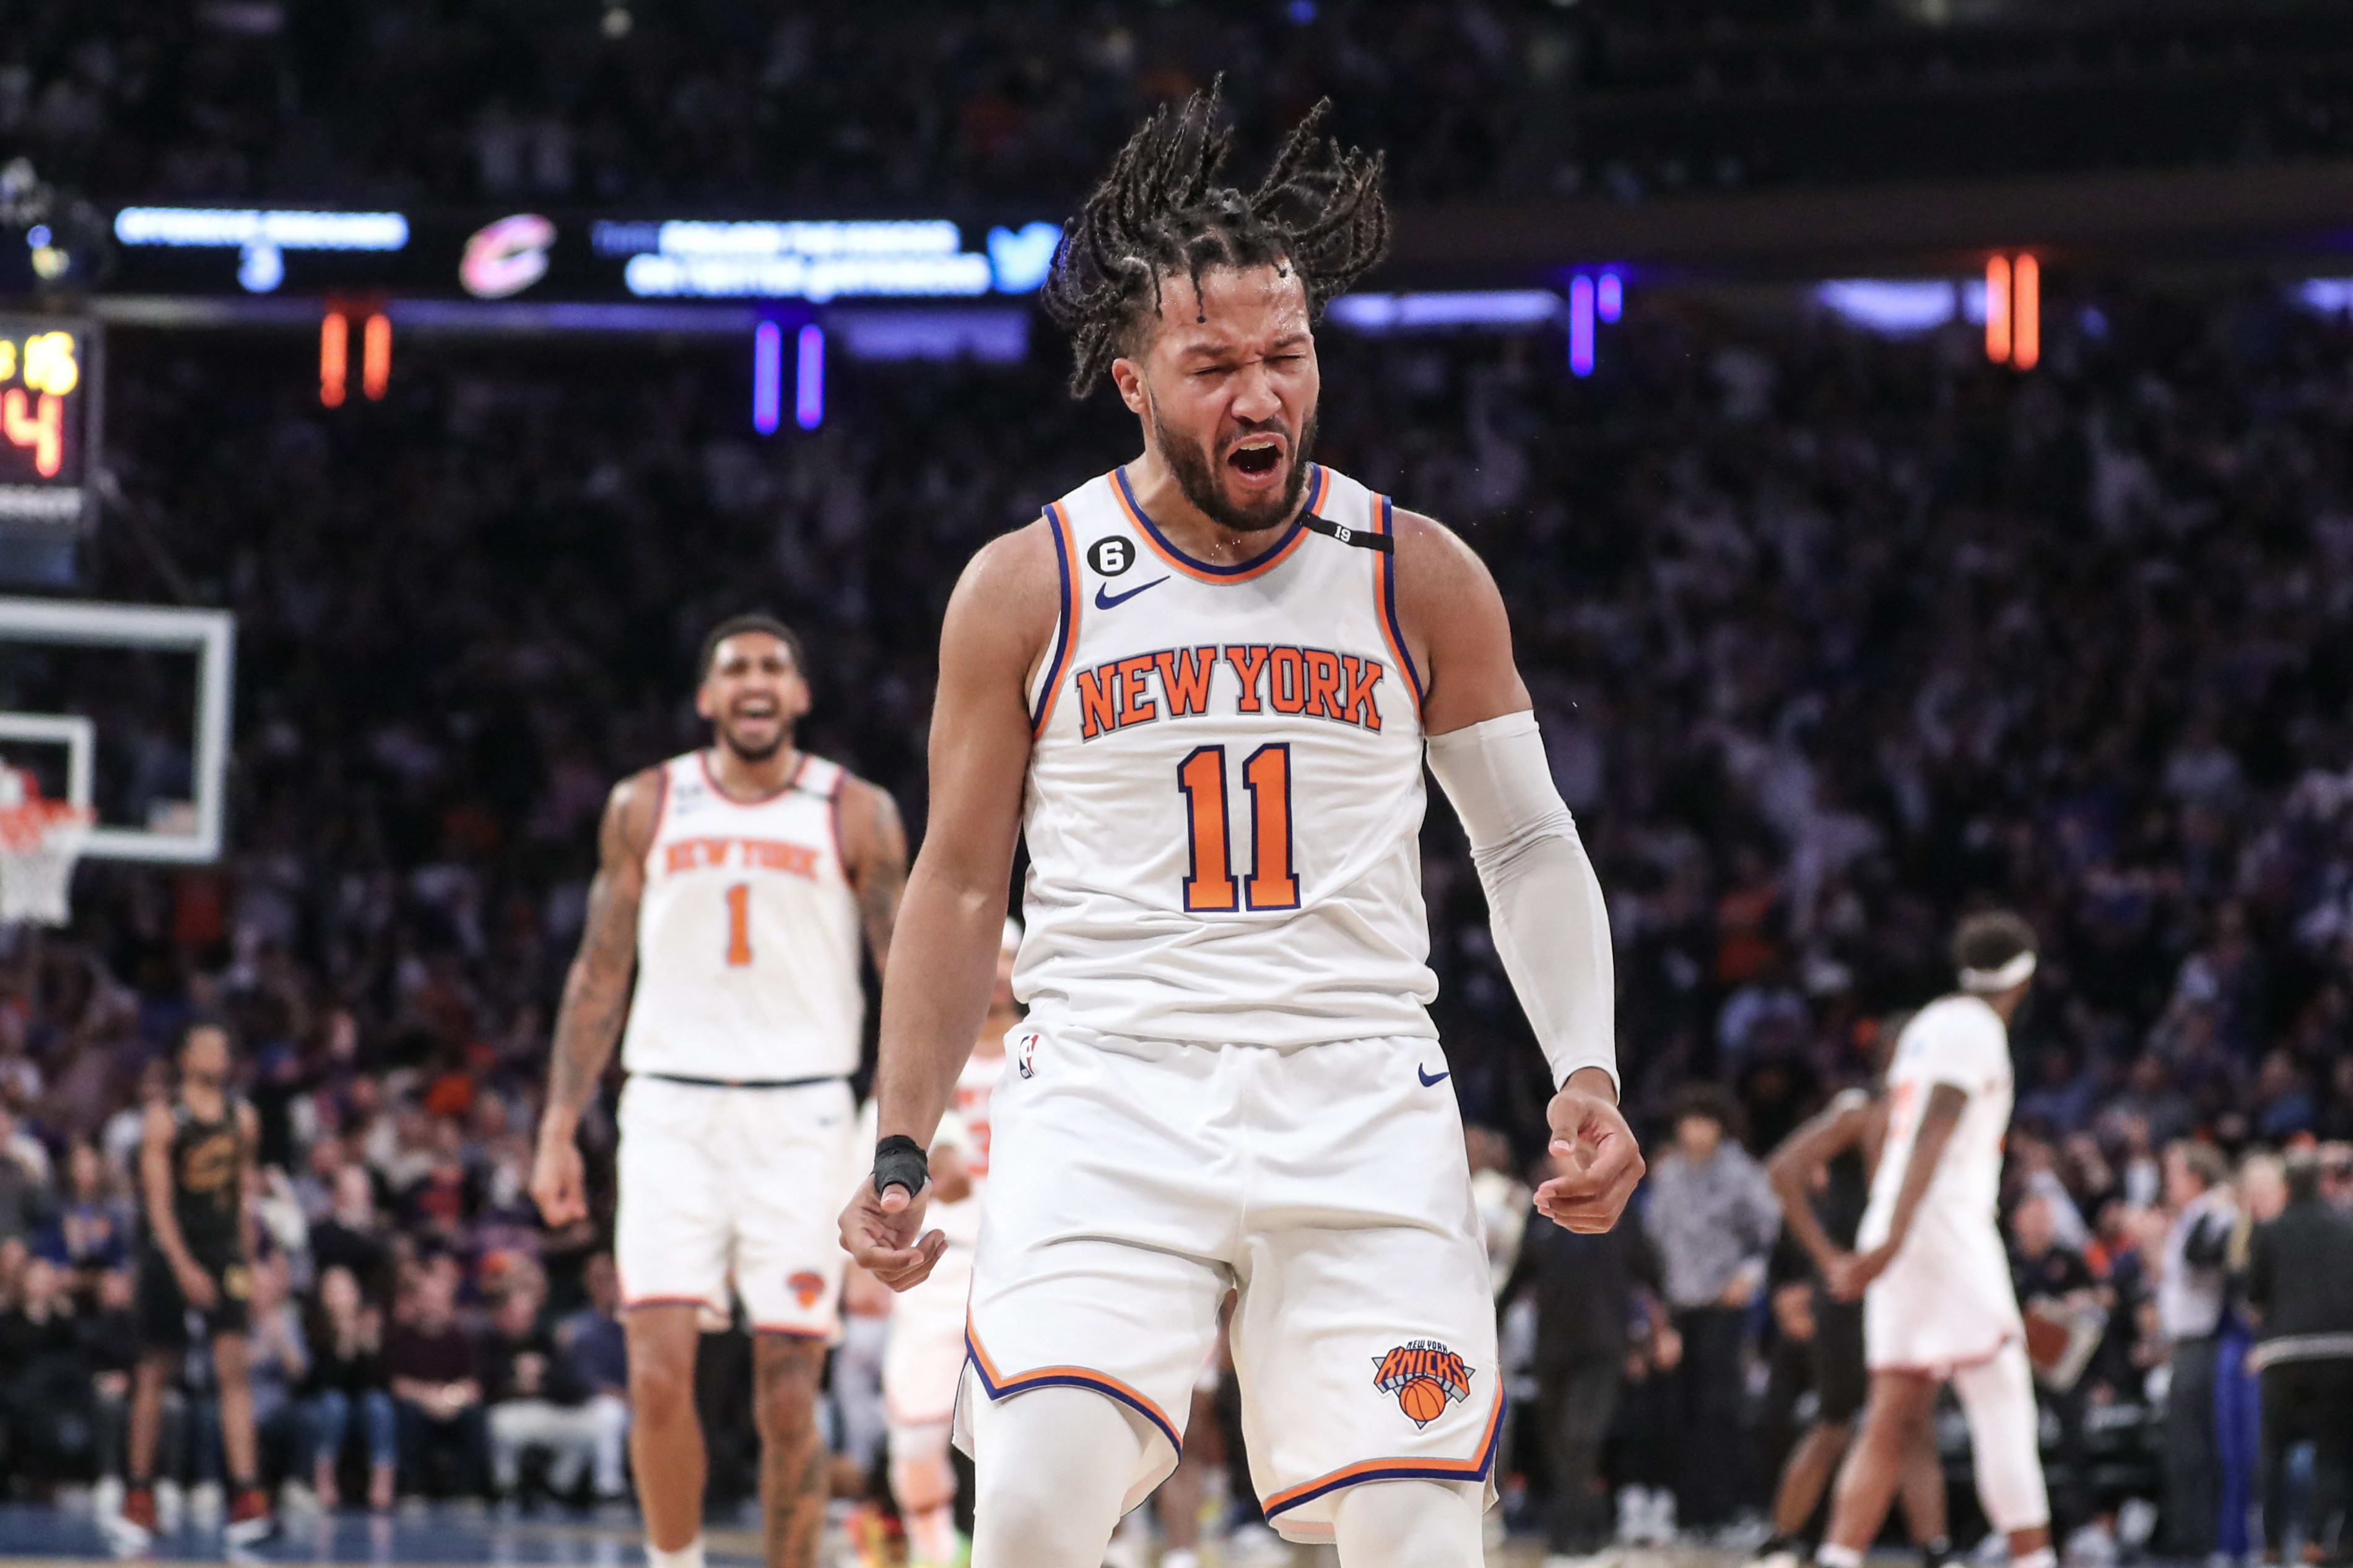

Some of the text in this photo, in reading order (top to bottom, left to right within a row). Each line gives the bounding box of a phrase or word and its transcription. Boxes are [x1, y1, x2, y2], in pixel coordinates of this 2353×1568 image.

[1099, 540, 1124, 572] 6
[1334, 526, 1351, 542] 19
[1075, 644, 1383, 743] NEW YORK
[1177, 743, 1301, 912] 11
[726, 881, 752, 967] 1
[1373, 1346, 1471, 1400] KNICKS
[1406, 1340, 1448, 1354] NEW YORK
